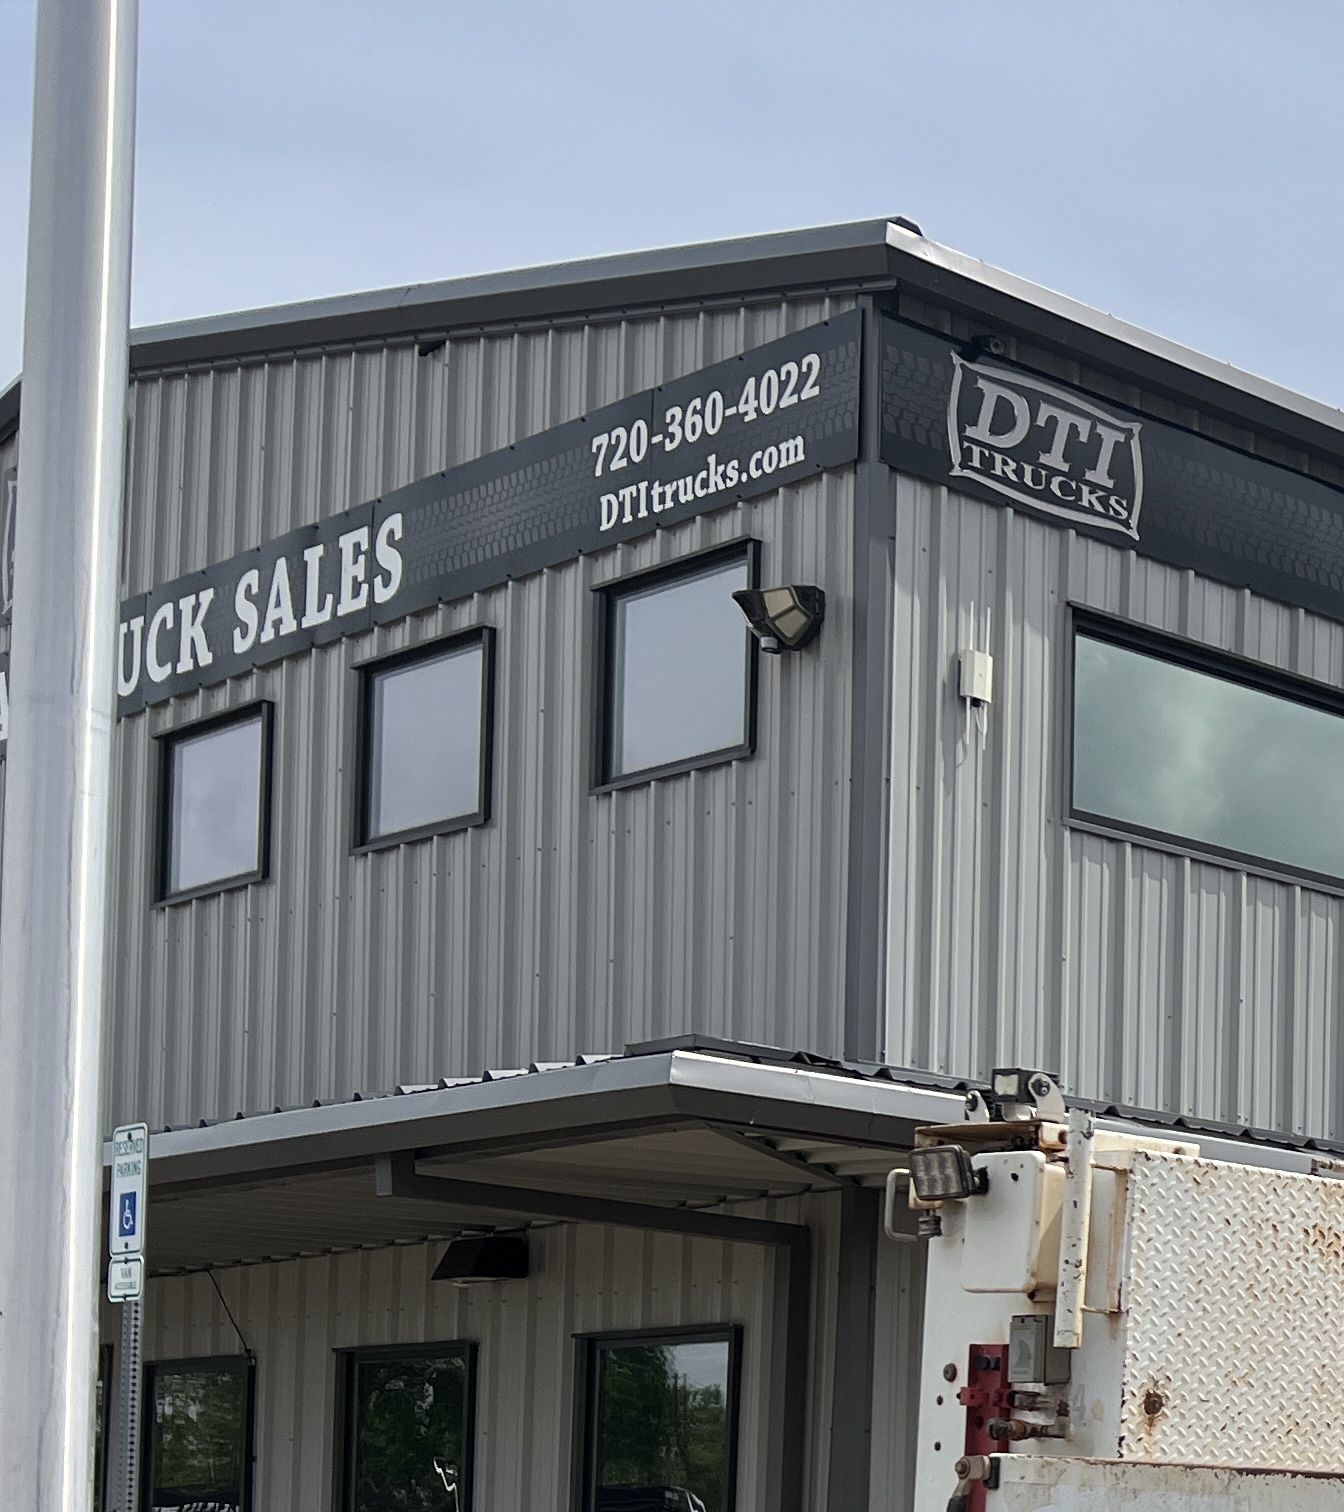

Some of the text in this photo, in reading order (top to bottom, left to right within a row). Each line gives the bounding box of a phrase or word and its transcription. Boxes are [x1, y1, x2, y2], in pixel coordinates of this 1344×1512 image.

[591, 353, 821, 477] 720-360-4022
[962, 376, 1128, 489] DTI
[599, 435, 805, 531] DTItrucks.com
[963, 441, 1129, 520] TRUCKS
[117, 512, 403, 697] UCK SALES
[115, 1138, 144, 1156] RESERVED
[116, 1160, 141, 1178] PARKING
